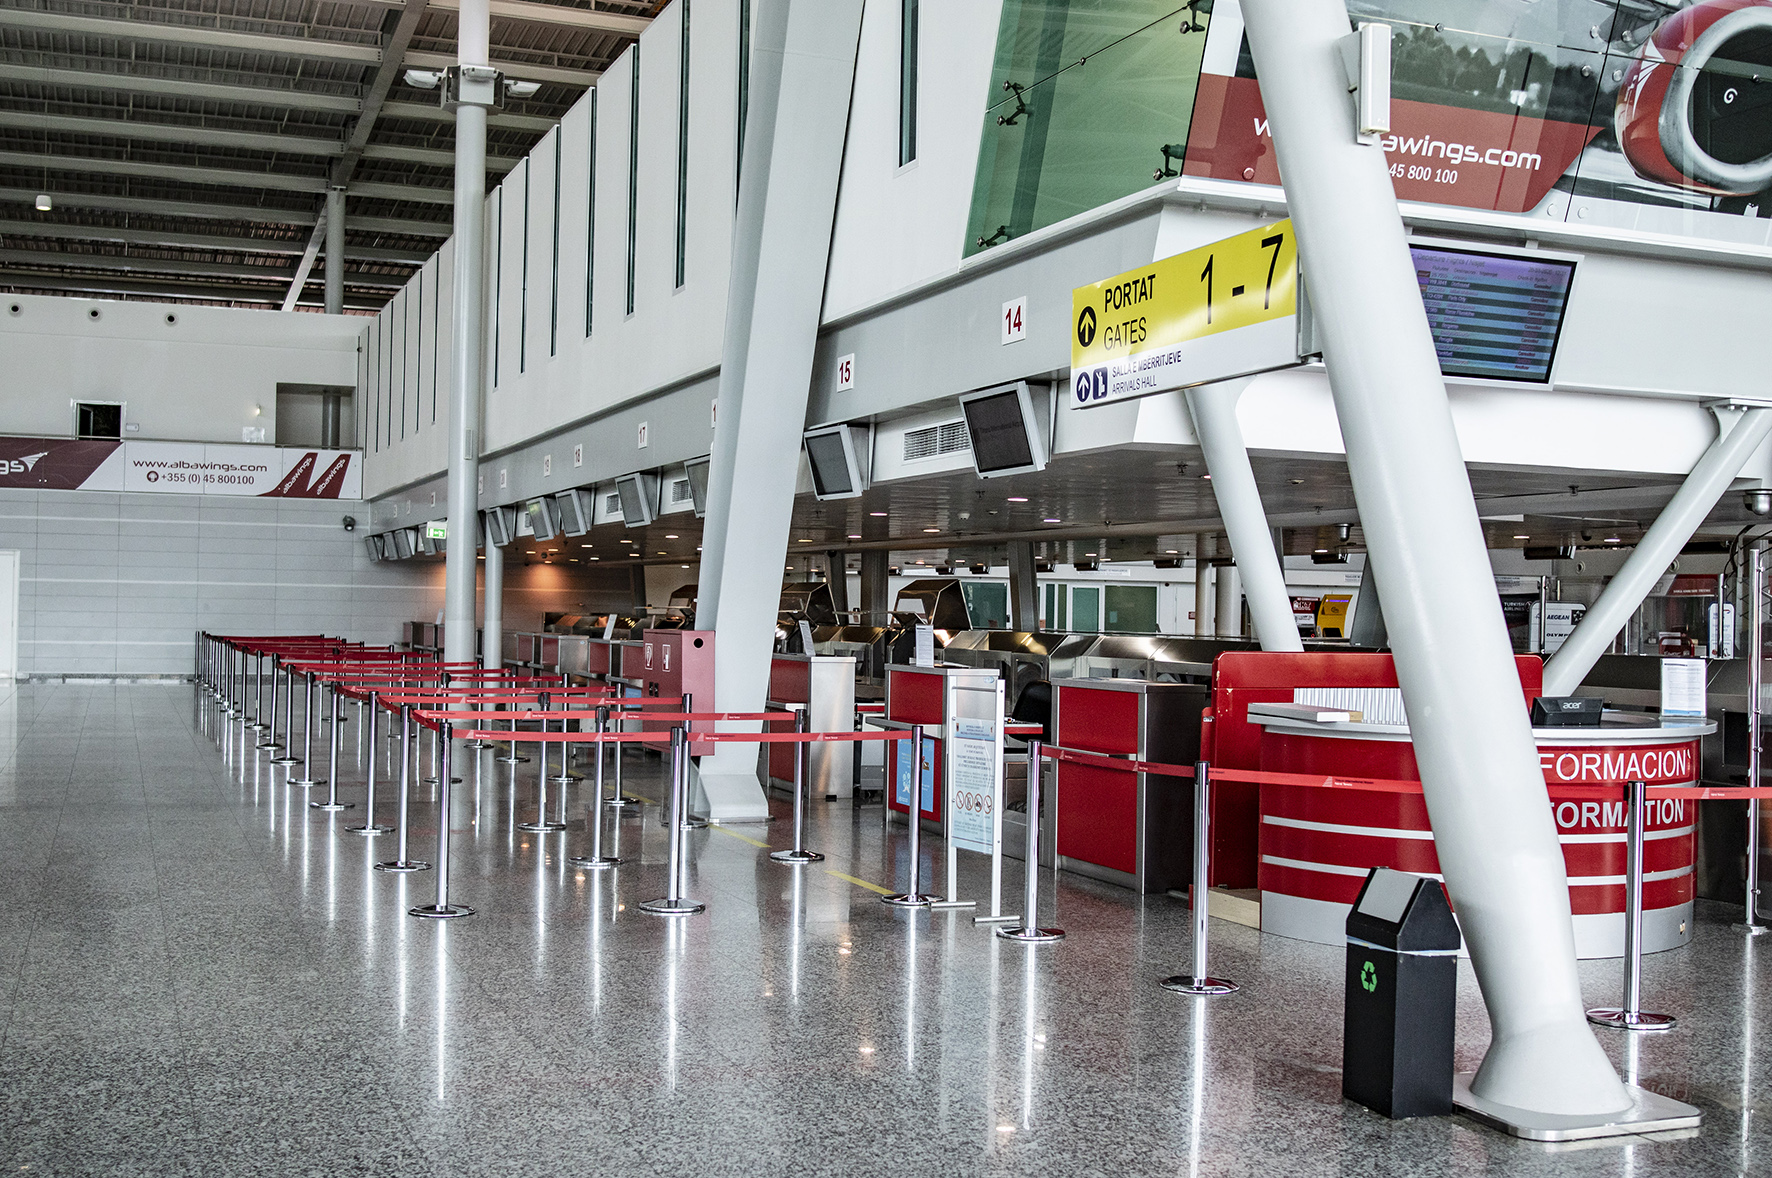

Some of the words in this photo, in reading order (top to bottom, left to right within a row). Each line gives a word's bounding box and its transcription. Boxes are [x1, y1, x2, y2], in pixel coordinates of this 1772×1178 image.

[1388, 162, 1405, 178] 45
[1407, 164, 1432, 182] 800
[1434, 167, 1458, 185] 100
[1104, 273, 1156, 313] PORTAT
[1200, 253, 1214, 325] 1
[1260, 233, 1284, 310] 7
[1005, 305, 1022, 335] 14
[1103, 316, 1147, 351] GATES
[839, 360, 851, 384] 15
[1111, 362, 1132, 378] SALLA
[1132, 360, 1138, 373] E
[1111, 377, 1140, 395] ARRIVALS
[1141, 374, 1157, 389] HALL
[639, 426, 646, 443] 17
[133, 459, 268, 472] www.albawings.com
[283, 457, 313, 494] albawings
[316, 458, 346, 496] albawings
[161, 472, 186, 482] +355
[188, 473, 201, 484] (0)
[203, 473, 215, 483] 45
[217, 474, 255, 485] 800100
[1562, 701, 1581, 710] acer
[1550, 799, 1684, 828] ORMTION
